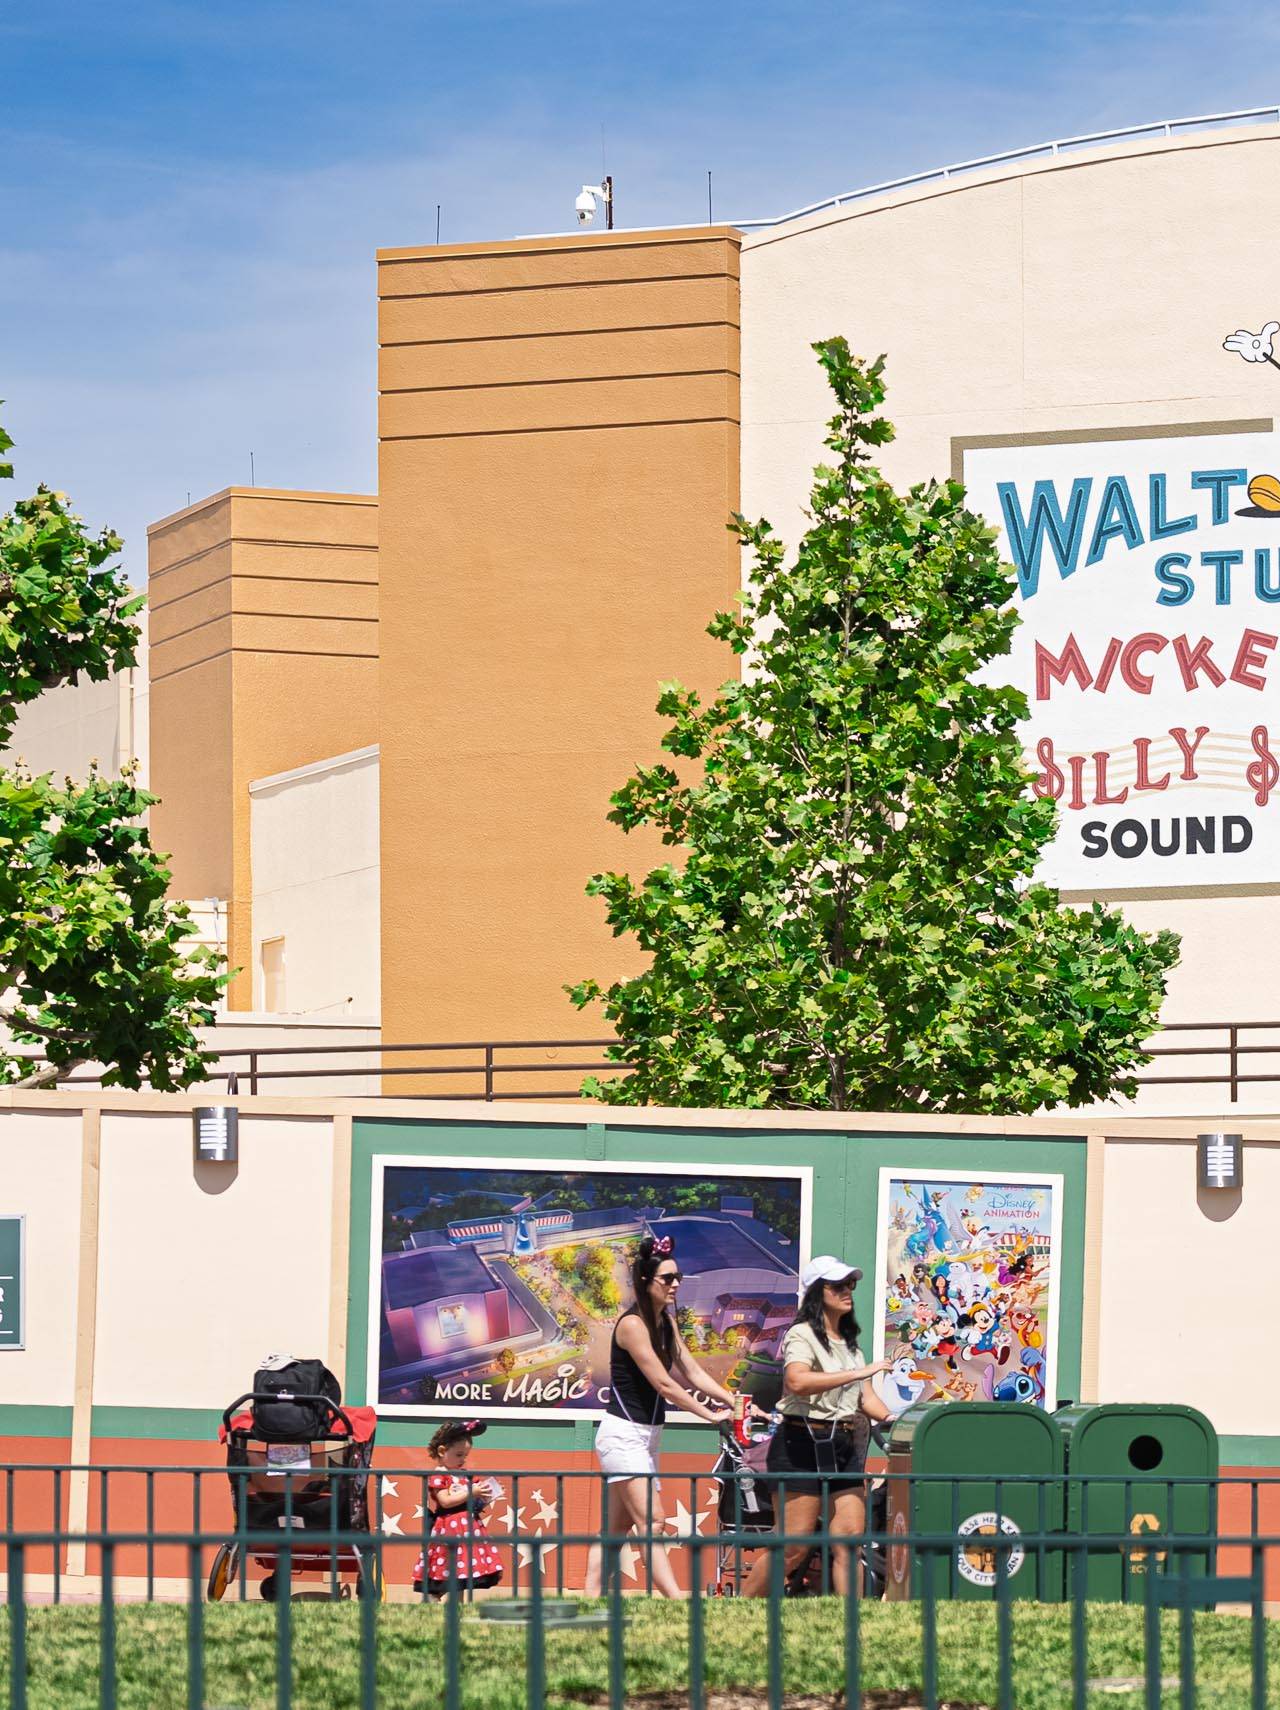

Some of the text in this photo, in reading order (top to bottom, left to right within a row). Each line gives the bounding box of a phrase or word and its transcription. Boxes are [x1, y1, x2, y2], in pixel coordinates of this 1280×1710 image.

[997, 468, 1248, 601] WALT
[1032, 726, 1210, 810] SILLY
[1081, 815, 1253, 859] SOUND
[984, 1209, 1040, 1218] ANIMATION
[435, 1383, 492, 1400] MORE
[503, 1363, 589, 1402] MAGIC
